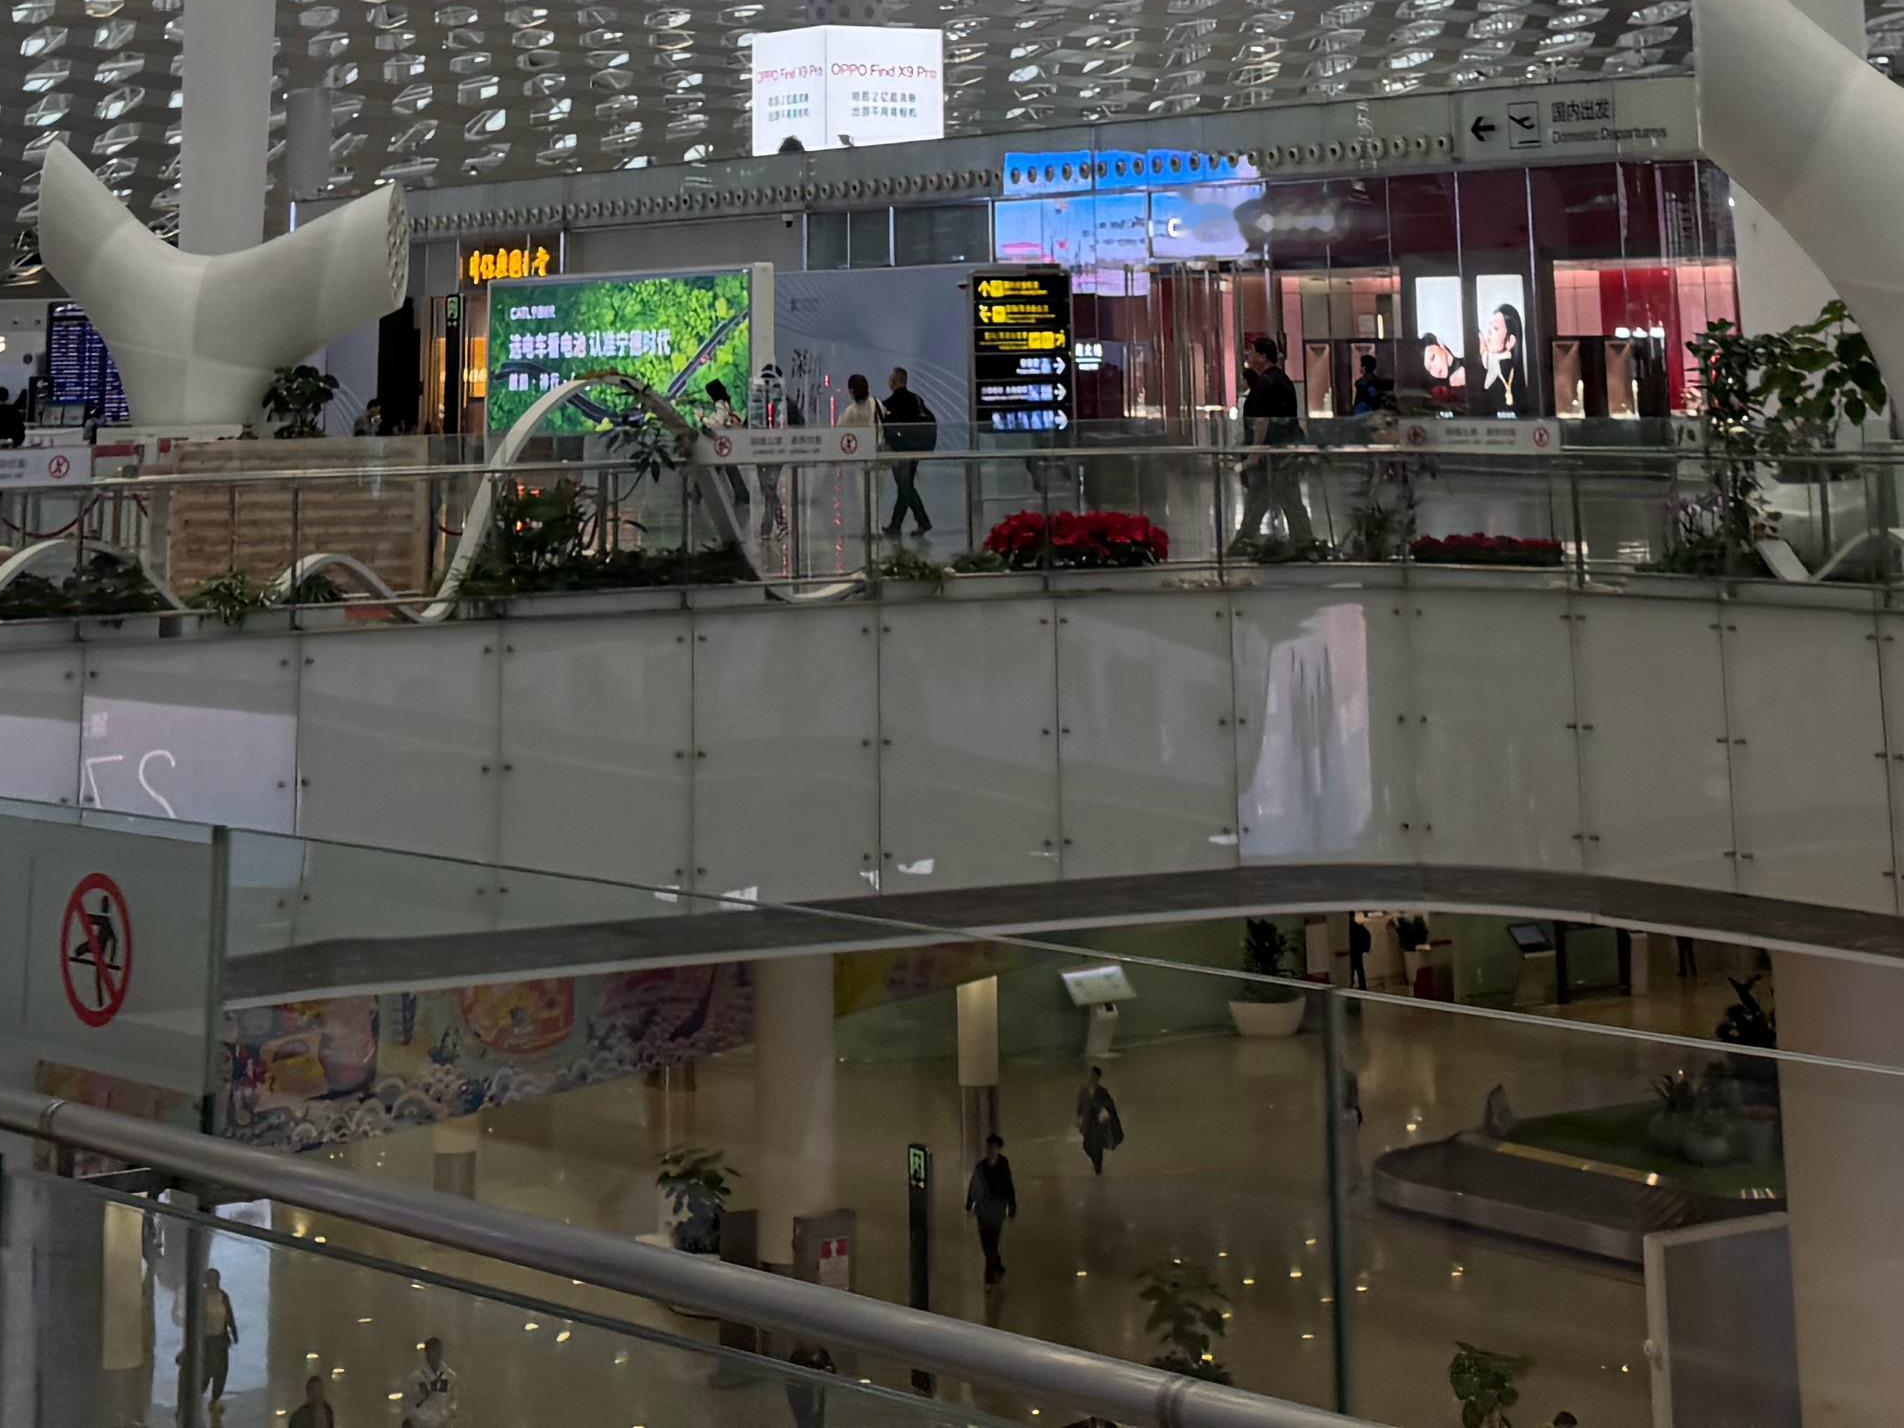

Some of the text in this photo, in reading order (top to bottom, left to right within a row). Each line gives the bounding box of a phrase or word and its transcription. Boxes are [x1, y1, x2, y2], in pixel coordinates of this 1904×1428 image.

[831, 63, 938, 79] OPPO Find X9 Pro
[1551, 98, 1611, 123] 国内出发
